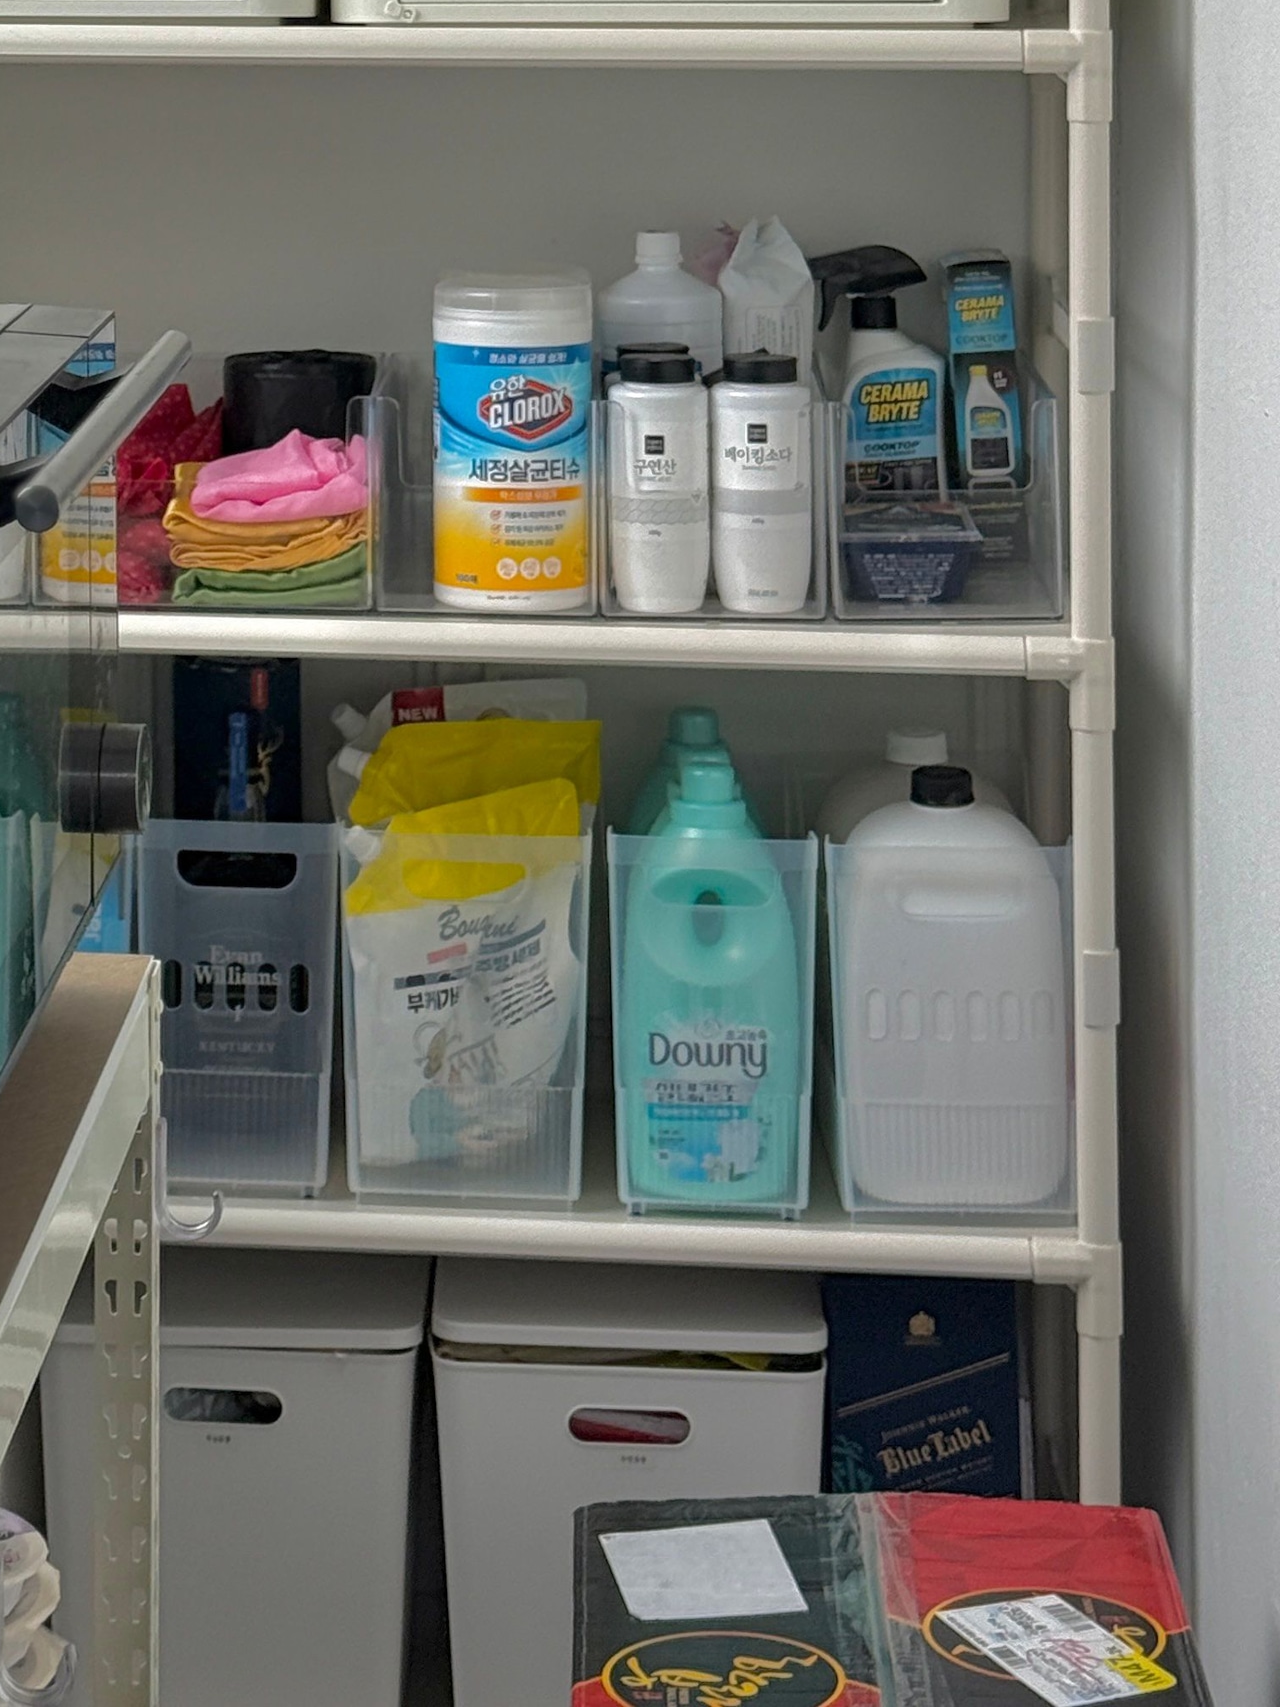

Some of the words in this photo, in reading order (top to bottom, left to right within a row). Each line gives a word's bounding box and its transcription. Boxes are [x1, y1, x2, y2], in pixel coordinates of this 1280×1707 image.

[955, 295, 1005, 312] CERAMA
[960, 307, 998, 322] BRYTE
[490, 374, 526, 401] 유한
[860, 380, 929, 405] CERAMA
[489, 387, 568, 430] CLOROX
[867, 400, 921, 423] BRYTE
[724, 446, 793, 465] 베이킹소다
[864, 440, 920, 454] COOKTOP
[469, 458, 580, 483] 세정살균티슈
[634, 458, 677, 475] 구연산
[398, 705, 438, 721] NEW
[209, 945, 263, 964] Evan
[194, 963, 282, 985] Williams
[648, 1032, 767, 1079] Downy
[877, 1444, 932, 1478] Blue
[927, 1419, 992, 1462] Label
